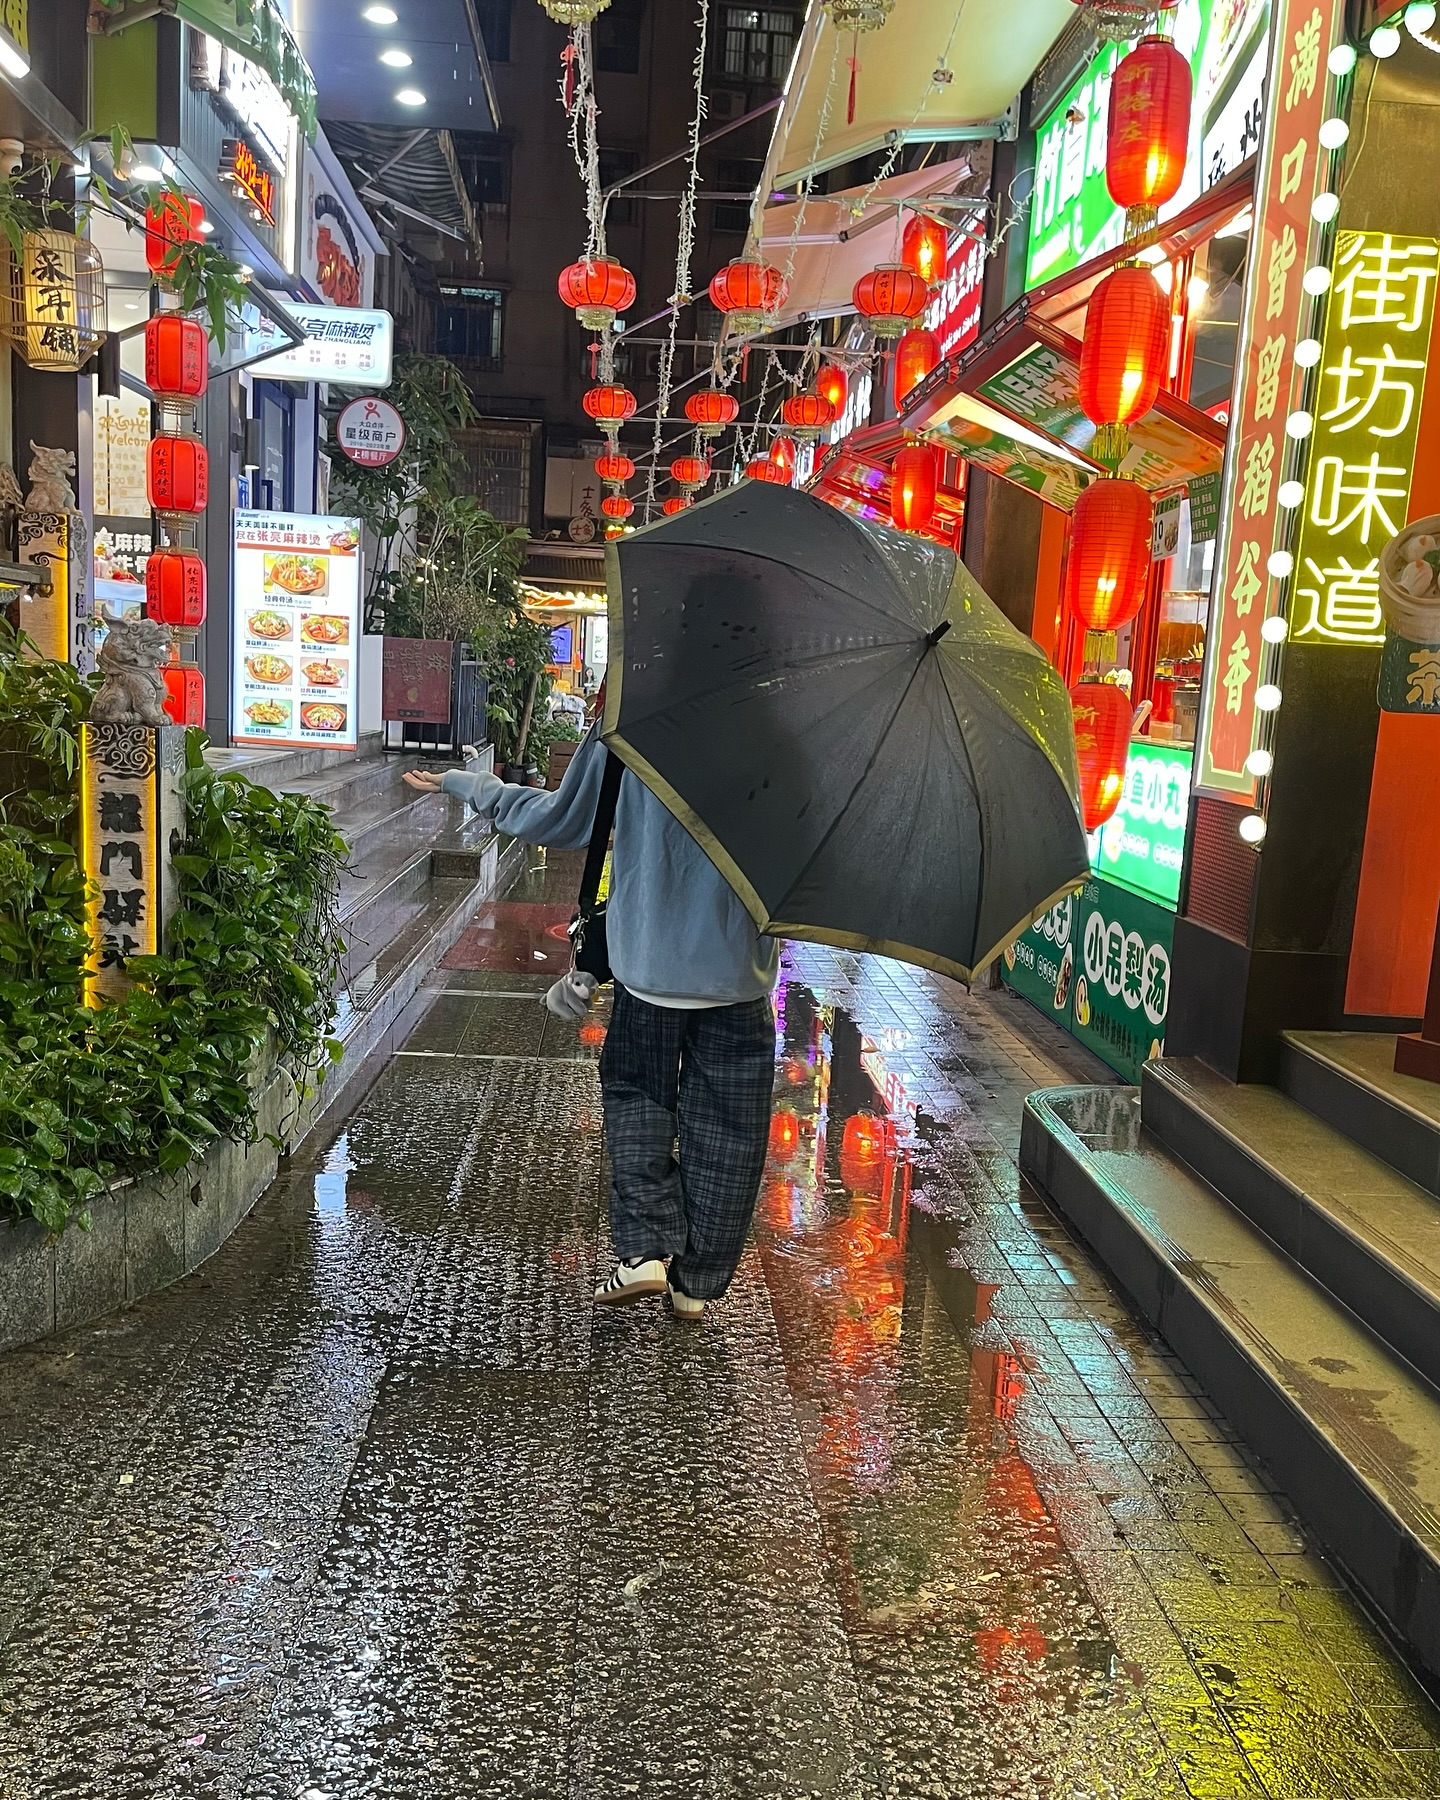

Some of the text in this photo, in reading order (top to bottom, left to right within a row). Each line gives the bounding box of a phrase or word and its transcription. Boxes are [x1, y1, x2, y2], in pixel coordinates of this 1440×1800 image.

[293, 316, 376, 341] 亮麻辣烫
[323, 336, 371, 346] ZHANGLIANG
[106, 433, 149, 446] Welcom
[346, 427, 396, 442] 星级商户
[1294, 234, 1438, 643] 街坊味道
[236, 530, 321, 546] 尽在张亮麻辣烫
[1406, 649, 1440, 704] 茶
[1123, 769, 1180, 815] 鱼小丸
[1088, 923, 1166, 1016] 小吊梨汤
